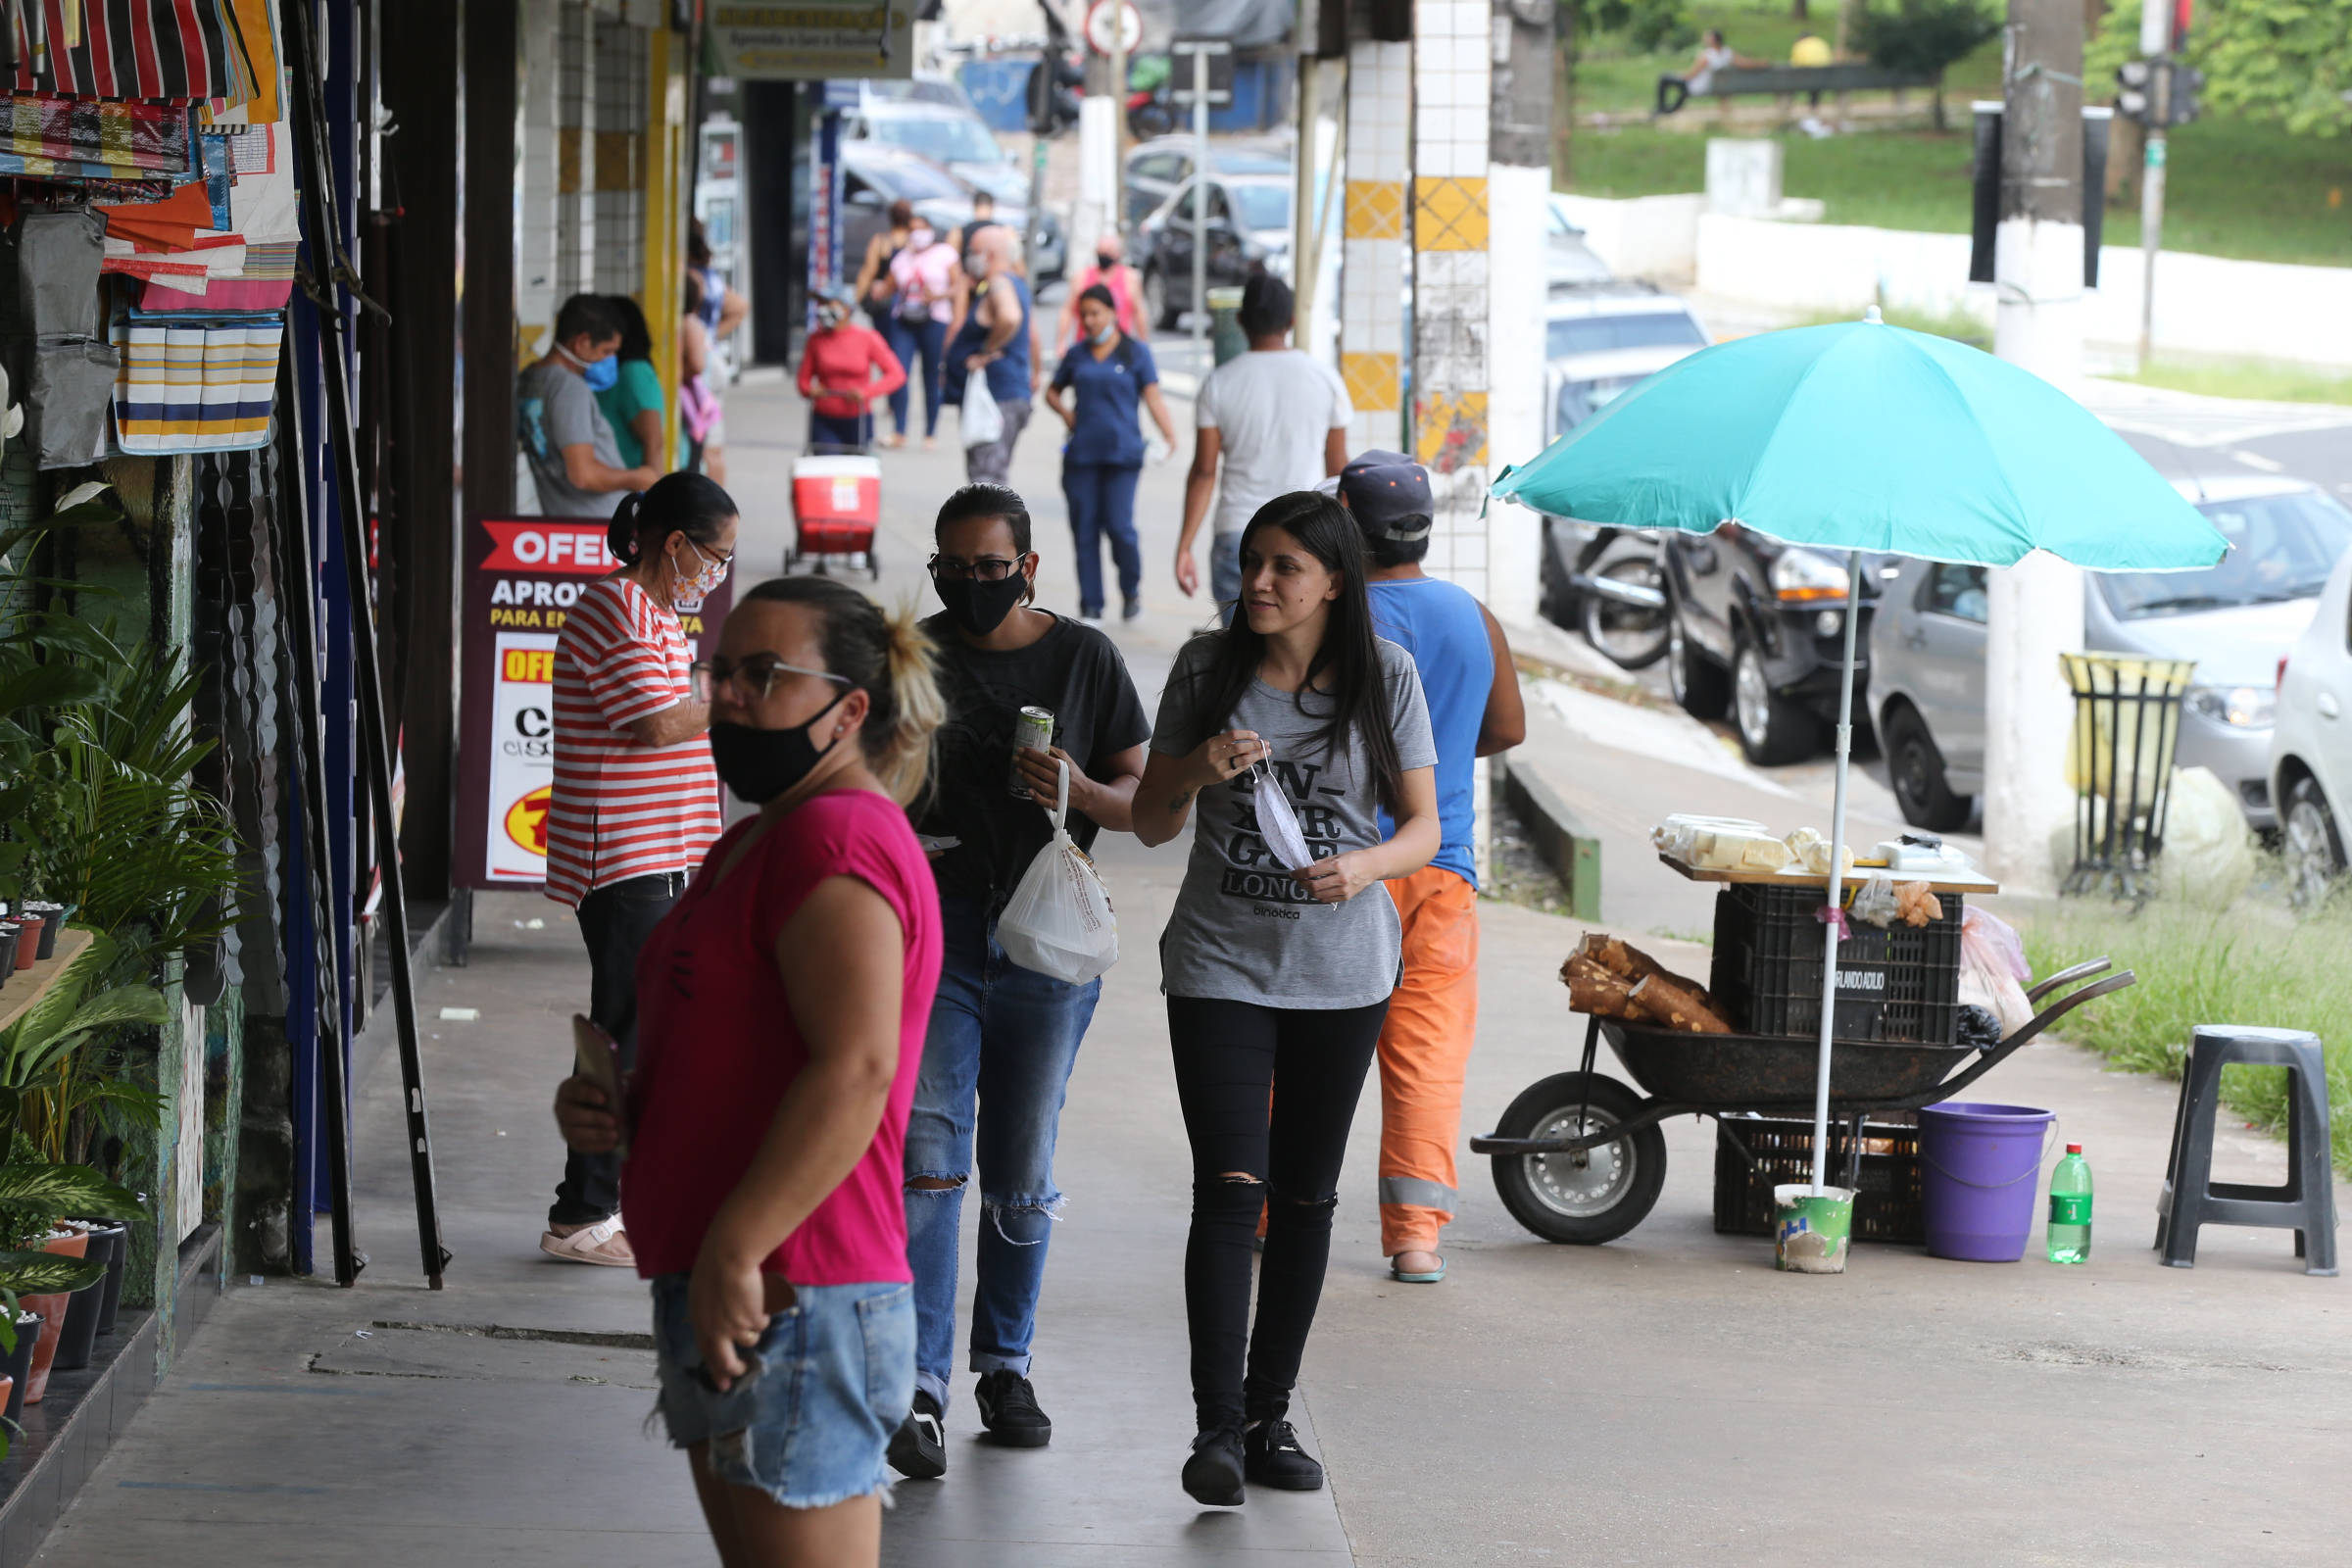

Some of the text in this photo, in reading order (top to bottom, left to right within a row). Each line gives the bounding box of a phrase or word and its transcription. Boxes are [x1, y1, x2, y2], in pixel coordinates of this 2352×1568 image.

[490, 609, 541, 627] PARA
[679, 615, 705, 634] TA
[1223, 870, 1319, 902] LONG
[1834, 970, 1863, 990] RLANDO
